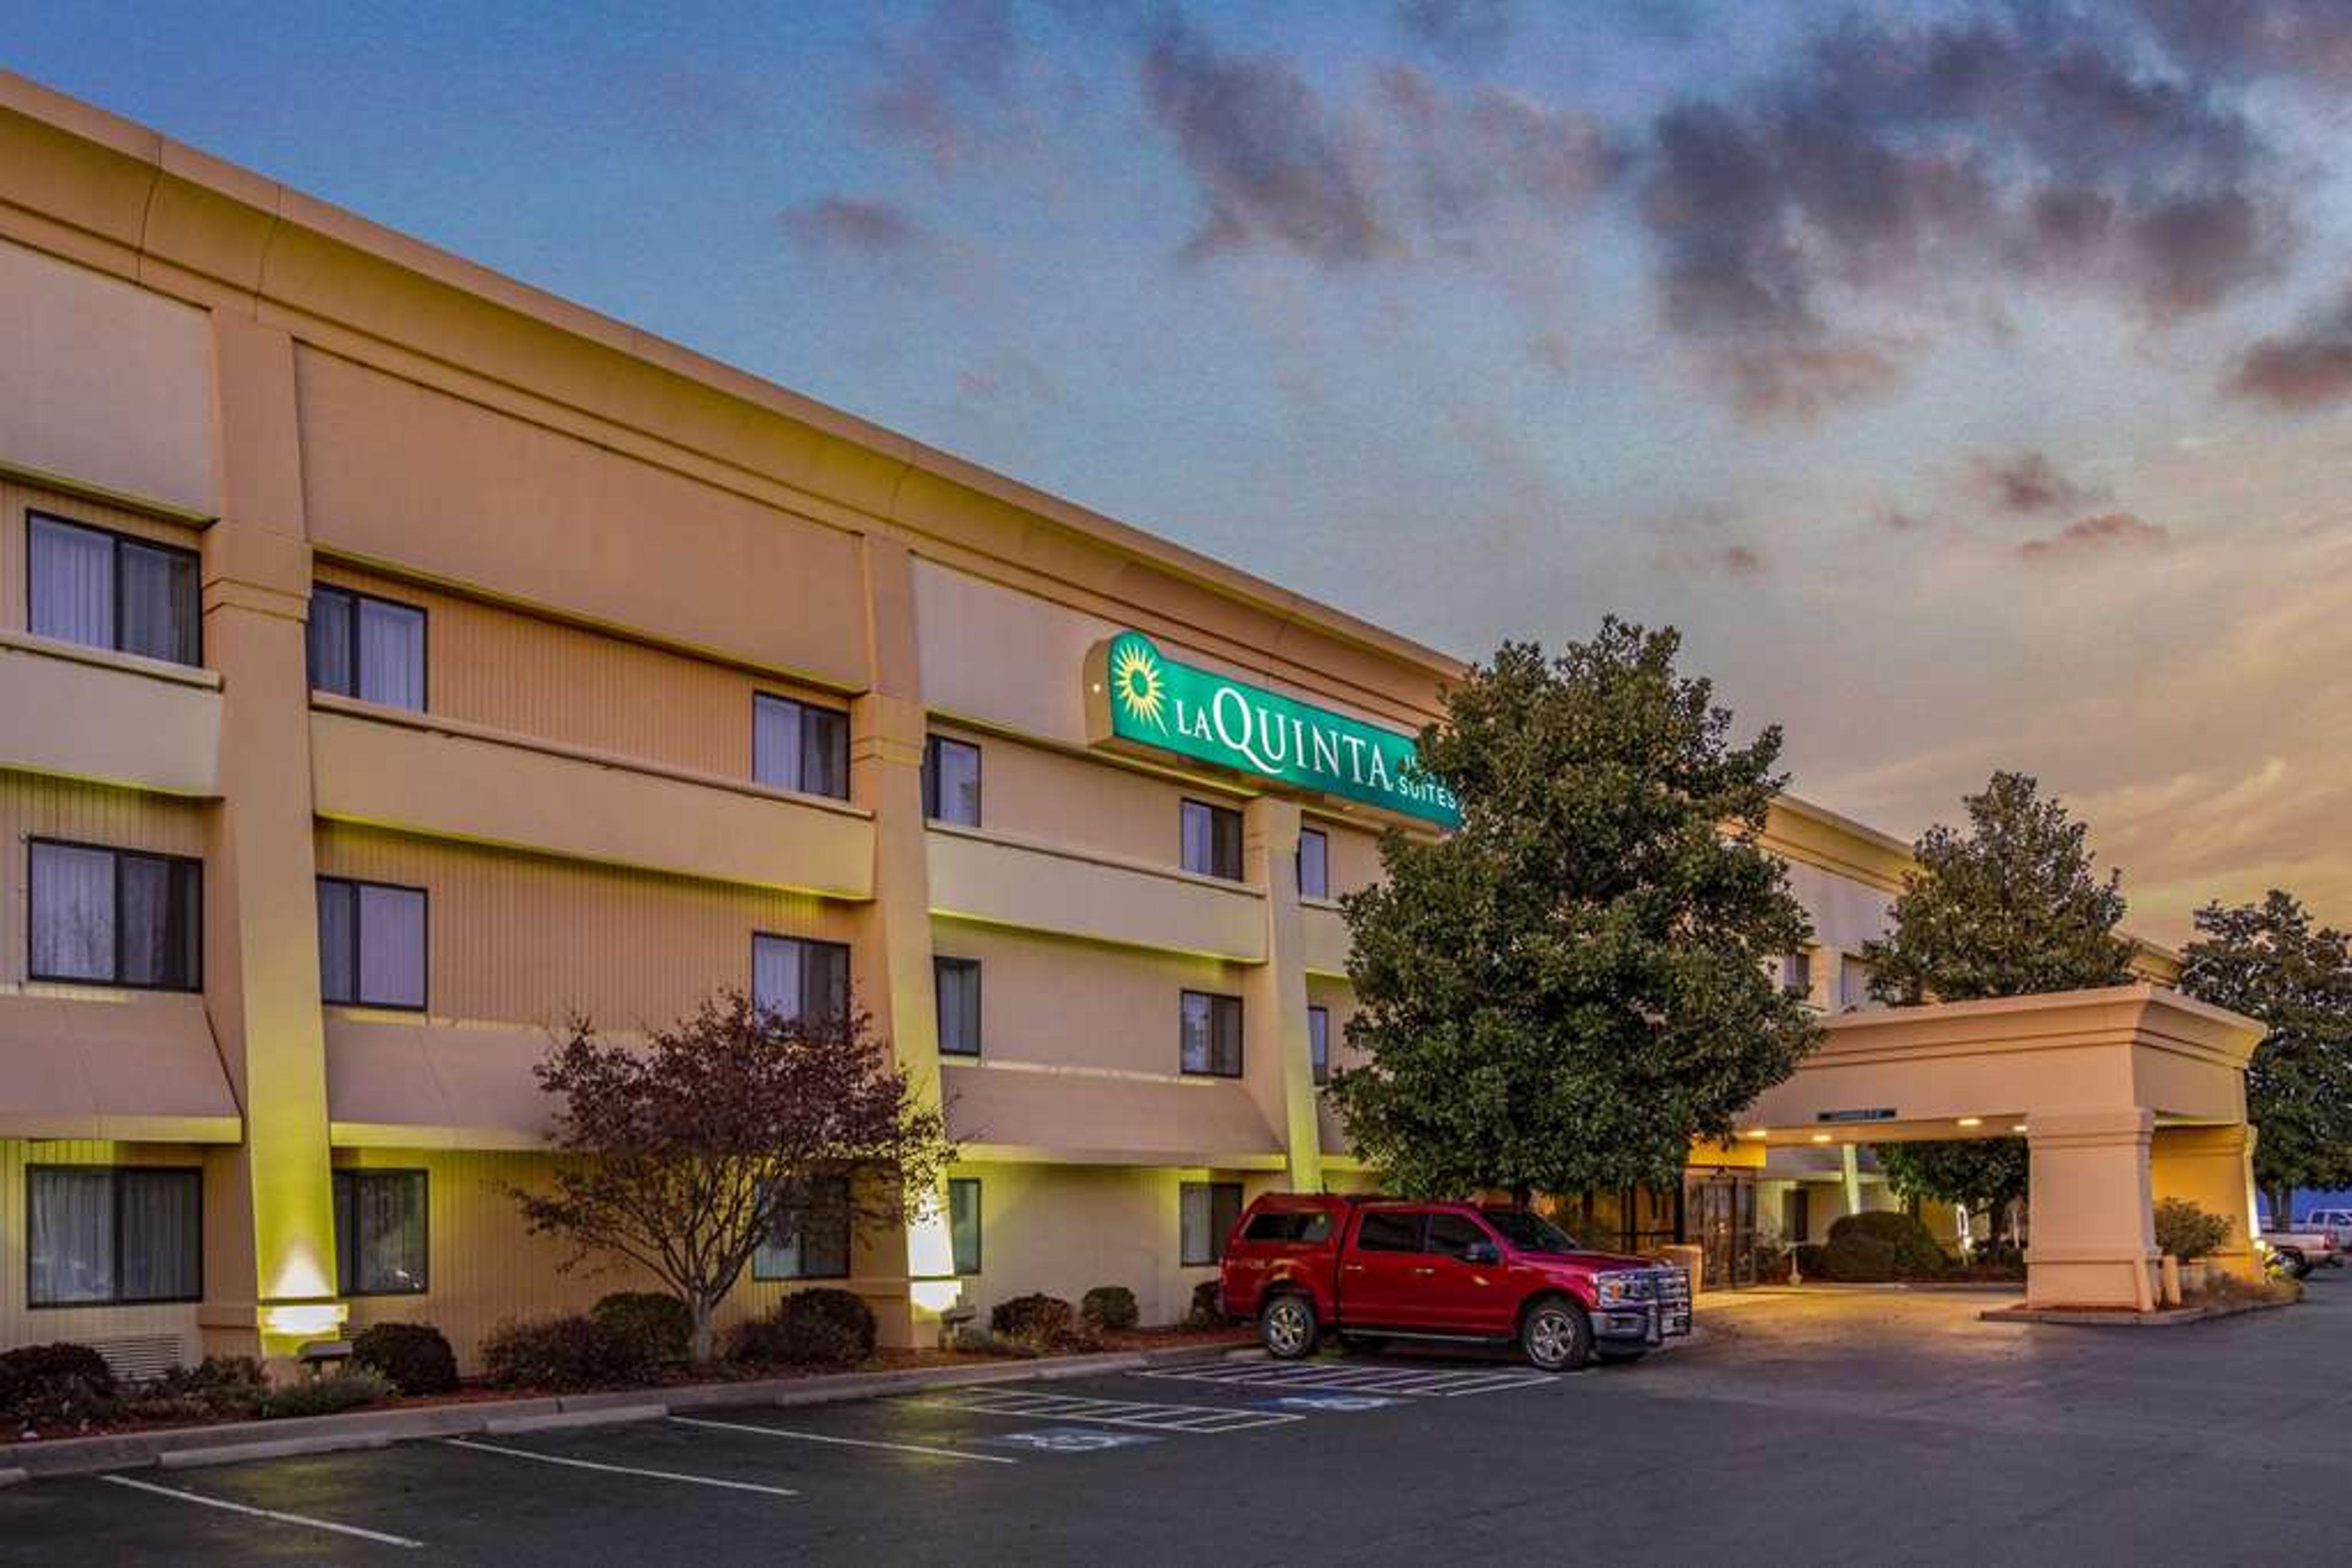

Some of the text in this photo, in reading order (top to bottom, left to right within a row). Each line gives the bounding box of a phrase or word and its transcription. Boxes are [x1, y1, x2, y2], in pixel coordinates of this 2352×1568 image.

[1176, 700, 1213, 742] LA
[1213, 687, 1394, 791] QUINTA
[1398, 775, 1456, 810] SUITES
